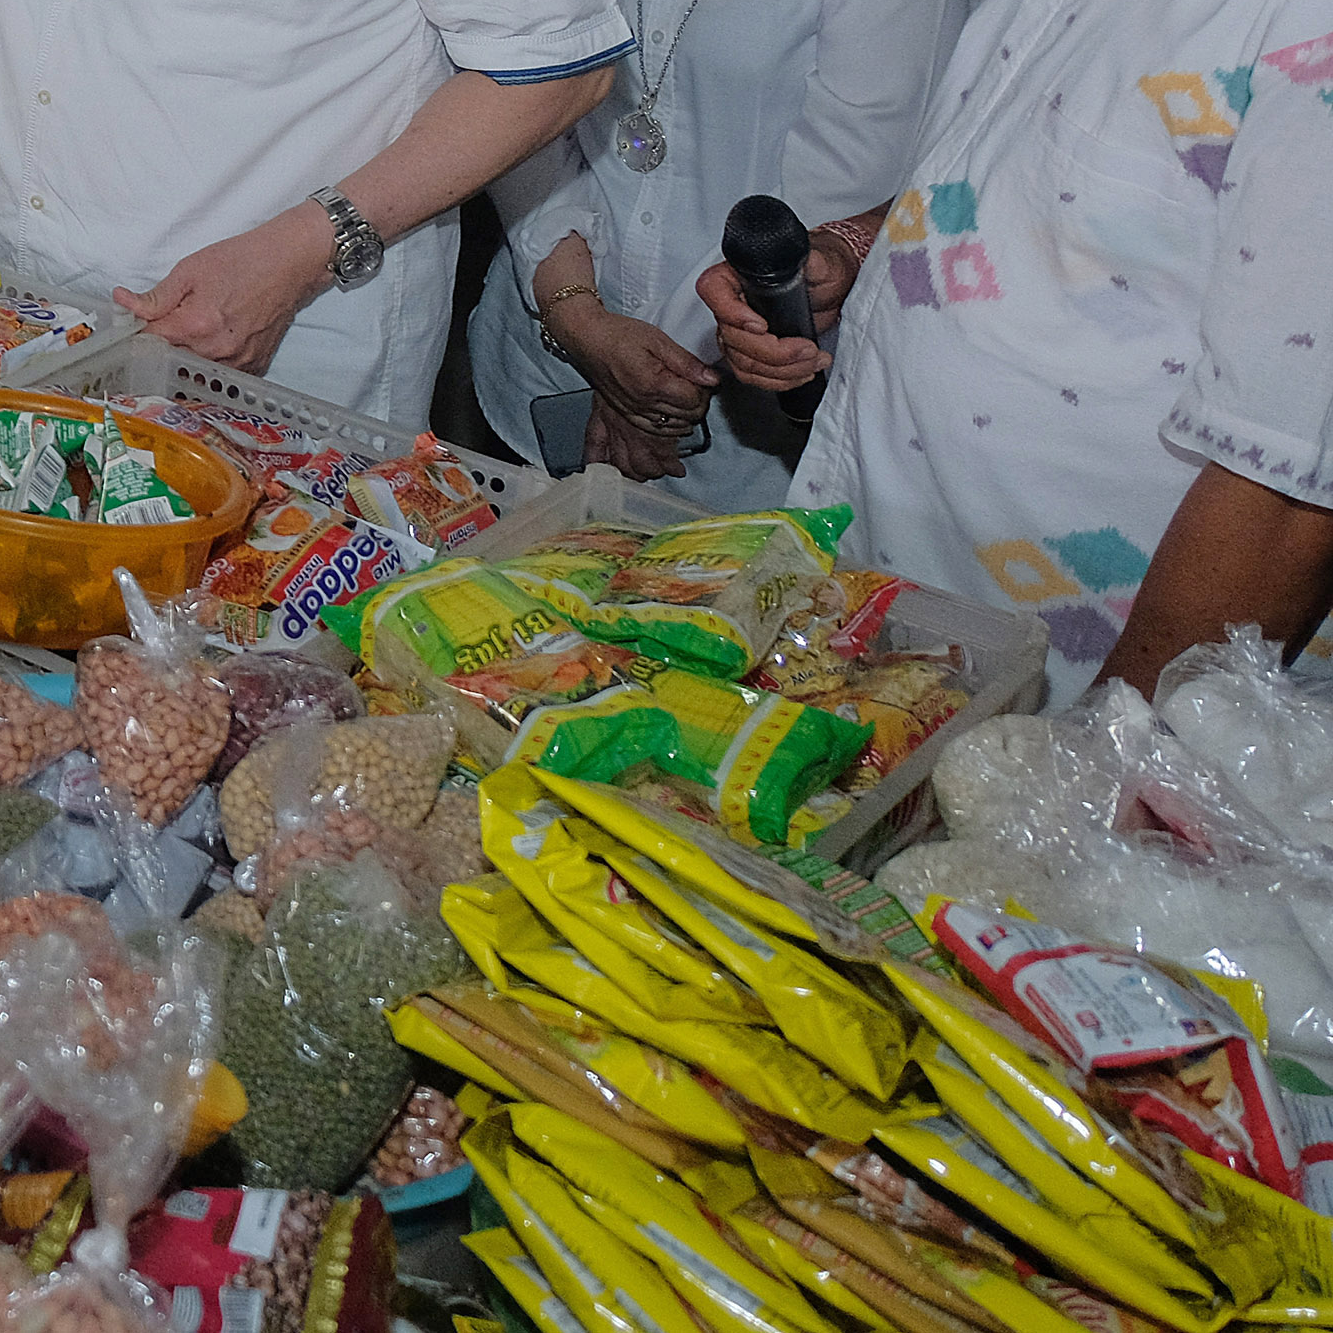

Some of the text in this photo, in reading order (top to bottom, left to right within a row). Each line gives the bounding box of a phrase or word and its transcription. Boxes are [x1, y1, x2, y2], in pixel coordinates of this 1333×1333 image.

[282, 528, 394, 640] Sedaap
[284, 553, 324, 601] Instant
[373, 549, 402, 581] Mie
